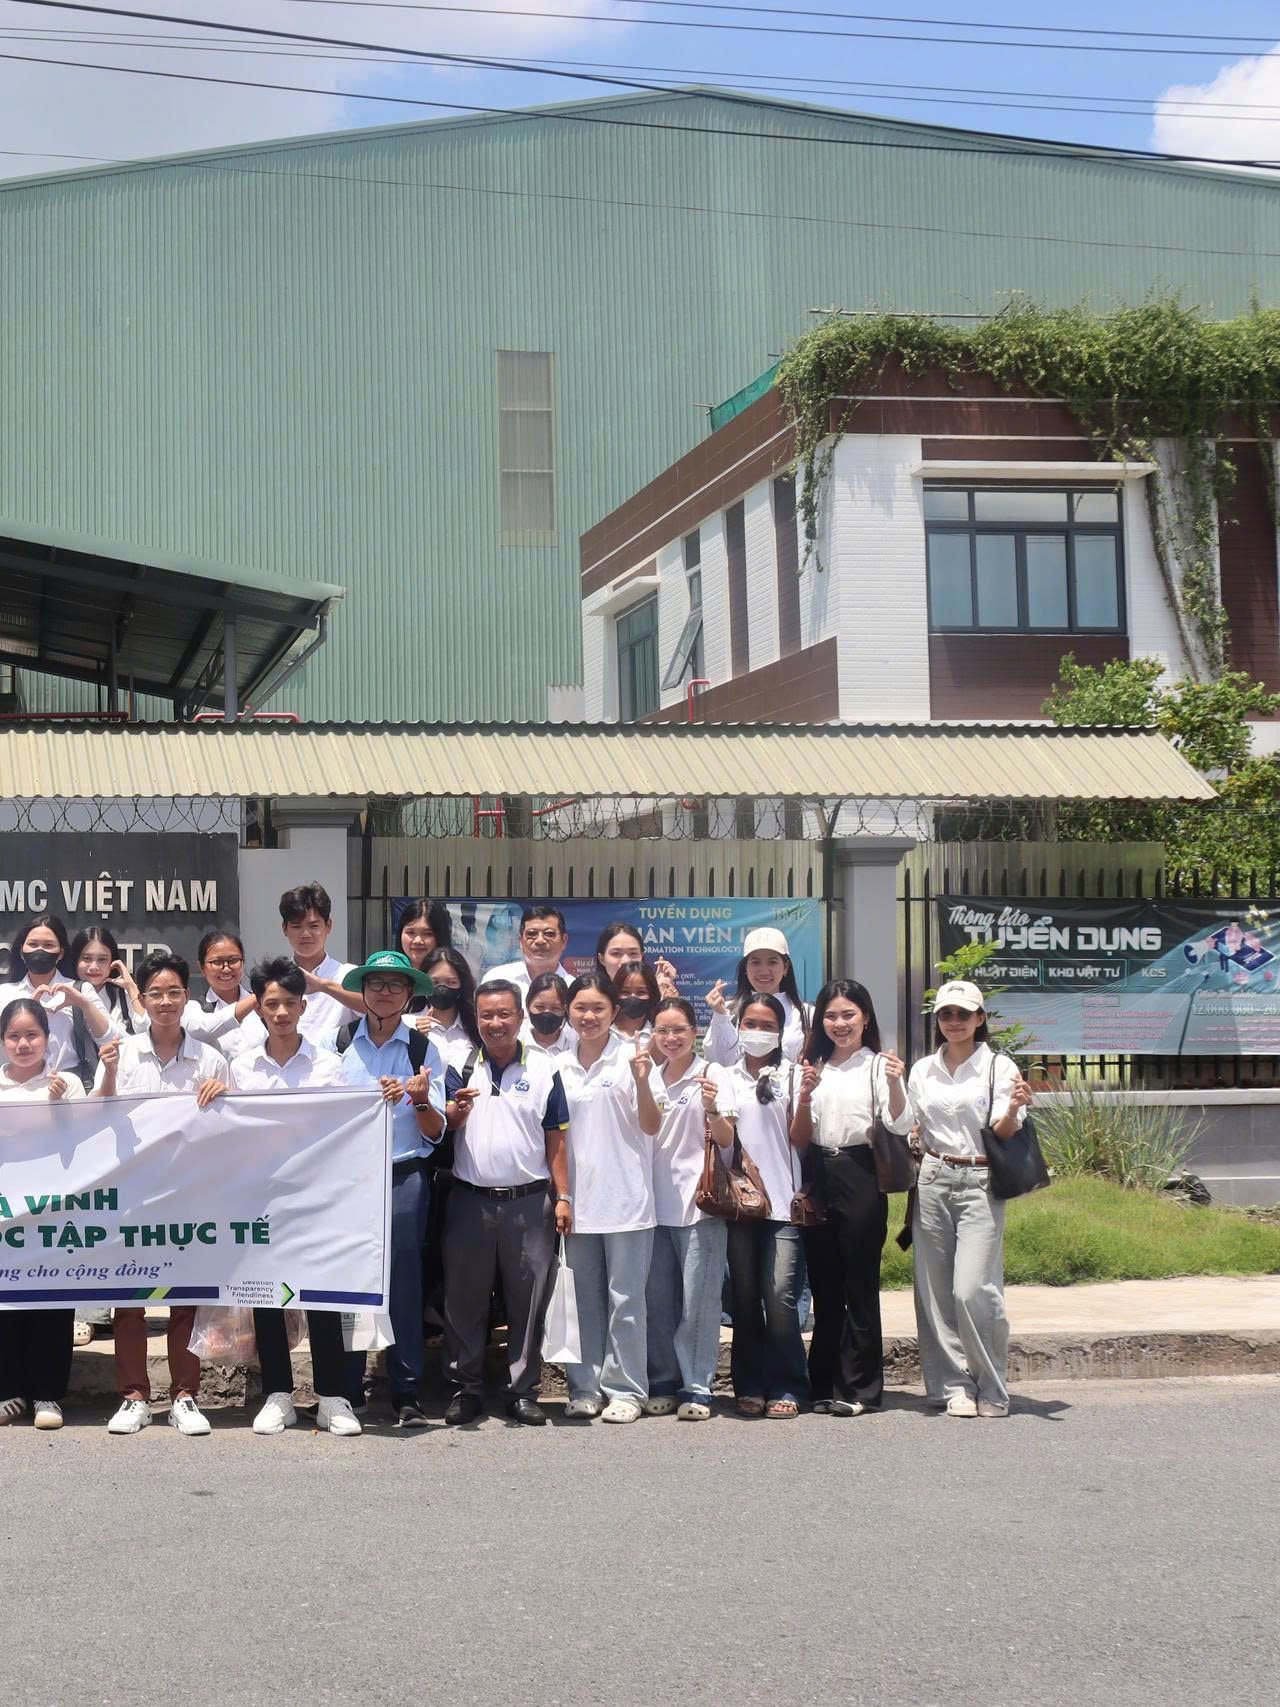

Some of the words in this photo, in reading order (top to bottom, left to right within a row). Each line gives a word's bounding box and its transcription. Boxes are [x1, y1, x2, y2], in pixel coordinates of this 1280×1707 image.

[61, 871, 134, 919] VIỆT
[145, 879, 217, 913] NAM
[690, 908, 733, 922] DỤNG
[681, 924, 732, 944] VIÊN
[964, 917, 1070, 951] TUYỂN
[1077, 927, 1162, 956] DỤNG
[1048, 967, 1074, 978] KHO
[1076, 965, 1101, 980] VẬT
[1142, 967, 1167, 978] KCS
[24, 1188, 119, 1215] VINH
[38, 1220, 107, 1254] TẬP
[120, 1222, 217, 1251] THỰC
[230, 1214, 270, 1244] TẾ
[27, 1264, 60, 1279] cho
[65, 1263, 109, 1282] cộng
[226, 1285, 274, 1293] Transparency
